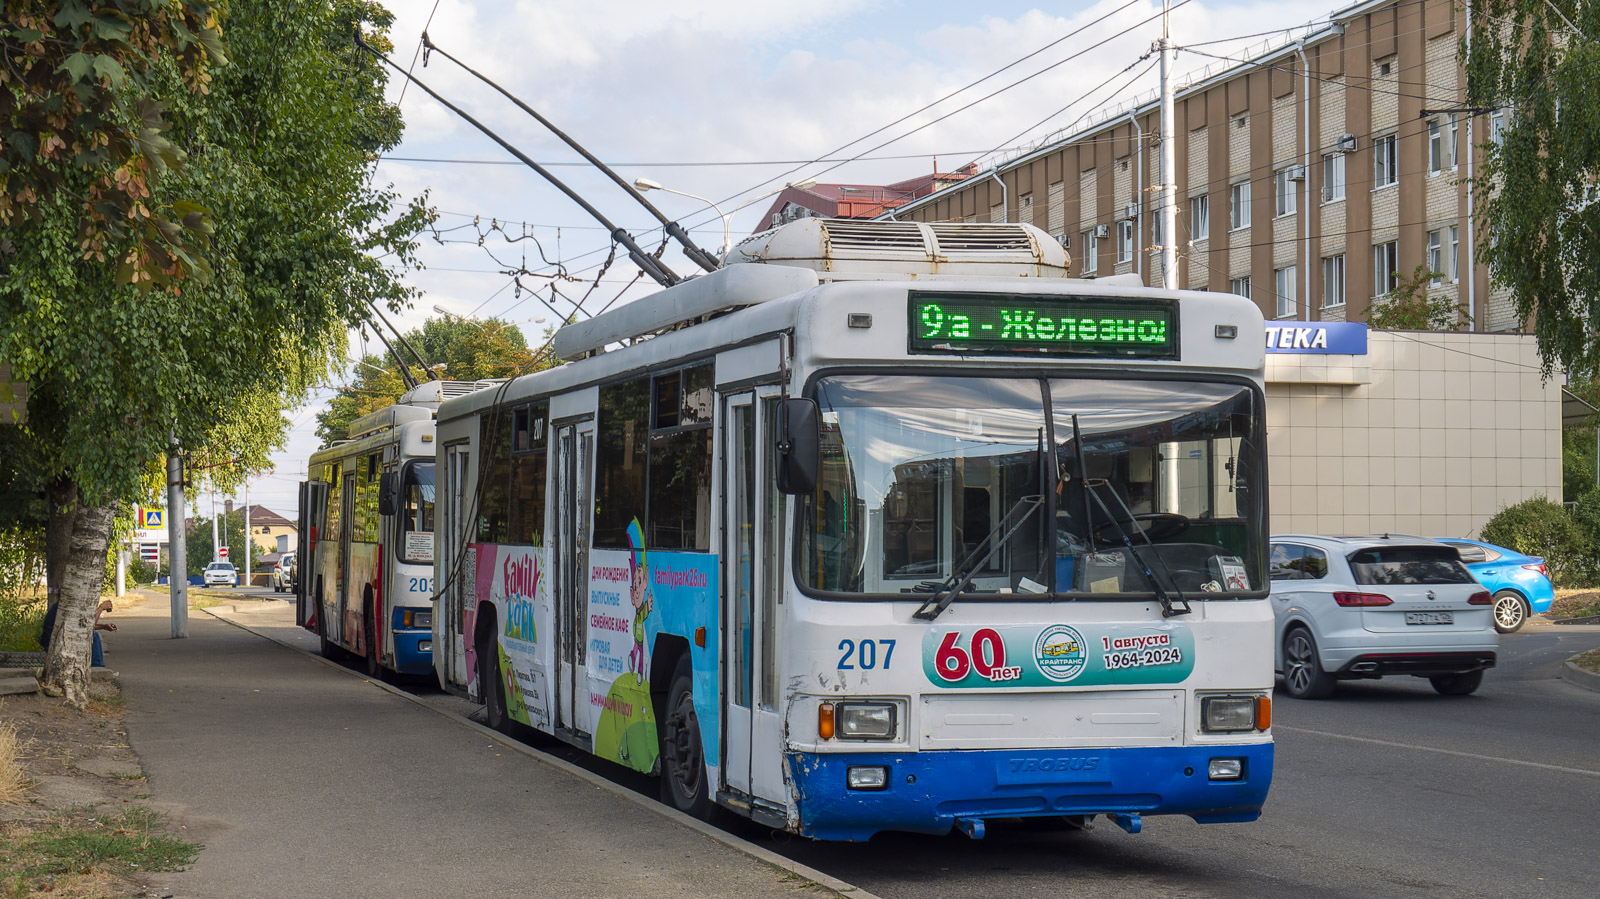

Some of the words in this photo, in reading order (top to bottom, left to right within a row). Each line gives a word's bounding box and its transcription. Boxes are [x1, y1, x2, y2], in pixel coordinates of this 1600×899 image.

[591, 566, 602, 581] ДНИ
[602, 567, 629, 583] РОЖДЕНИЯ
[654, 565, 707, 590] familypark26.ru
[591, 590, 620, 606] ВЫПУСКНЫЕ
[590, 613, 615, 631] СЕМЕЙНОЕ
[615, 618, 629, 633] КАФЕ
[589, 639, 611, 655] ИГРОВАЯ
[1102, 637, 1109, 650] 1
[1114, 634, 1169, 649] августа
[837, 639, 896, 670] 207
[935, 628, 1005, 680] 60
[990, 666, 1020, 681] лет
[1104, 648, 1180, 668] 1964-2024
[598, 655, 608, 670] ДЛЯ
[608, 657, 623, 673] ДЕТЕЙ
[1009, 757, 1100, 773] TROBUS
